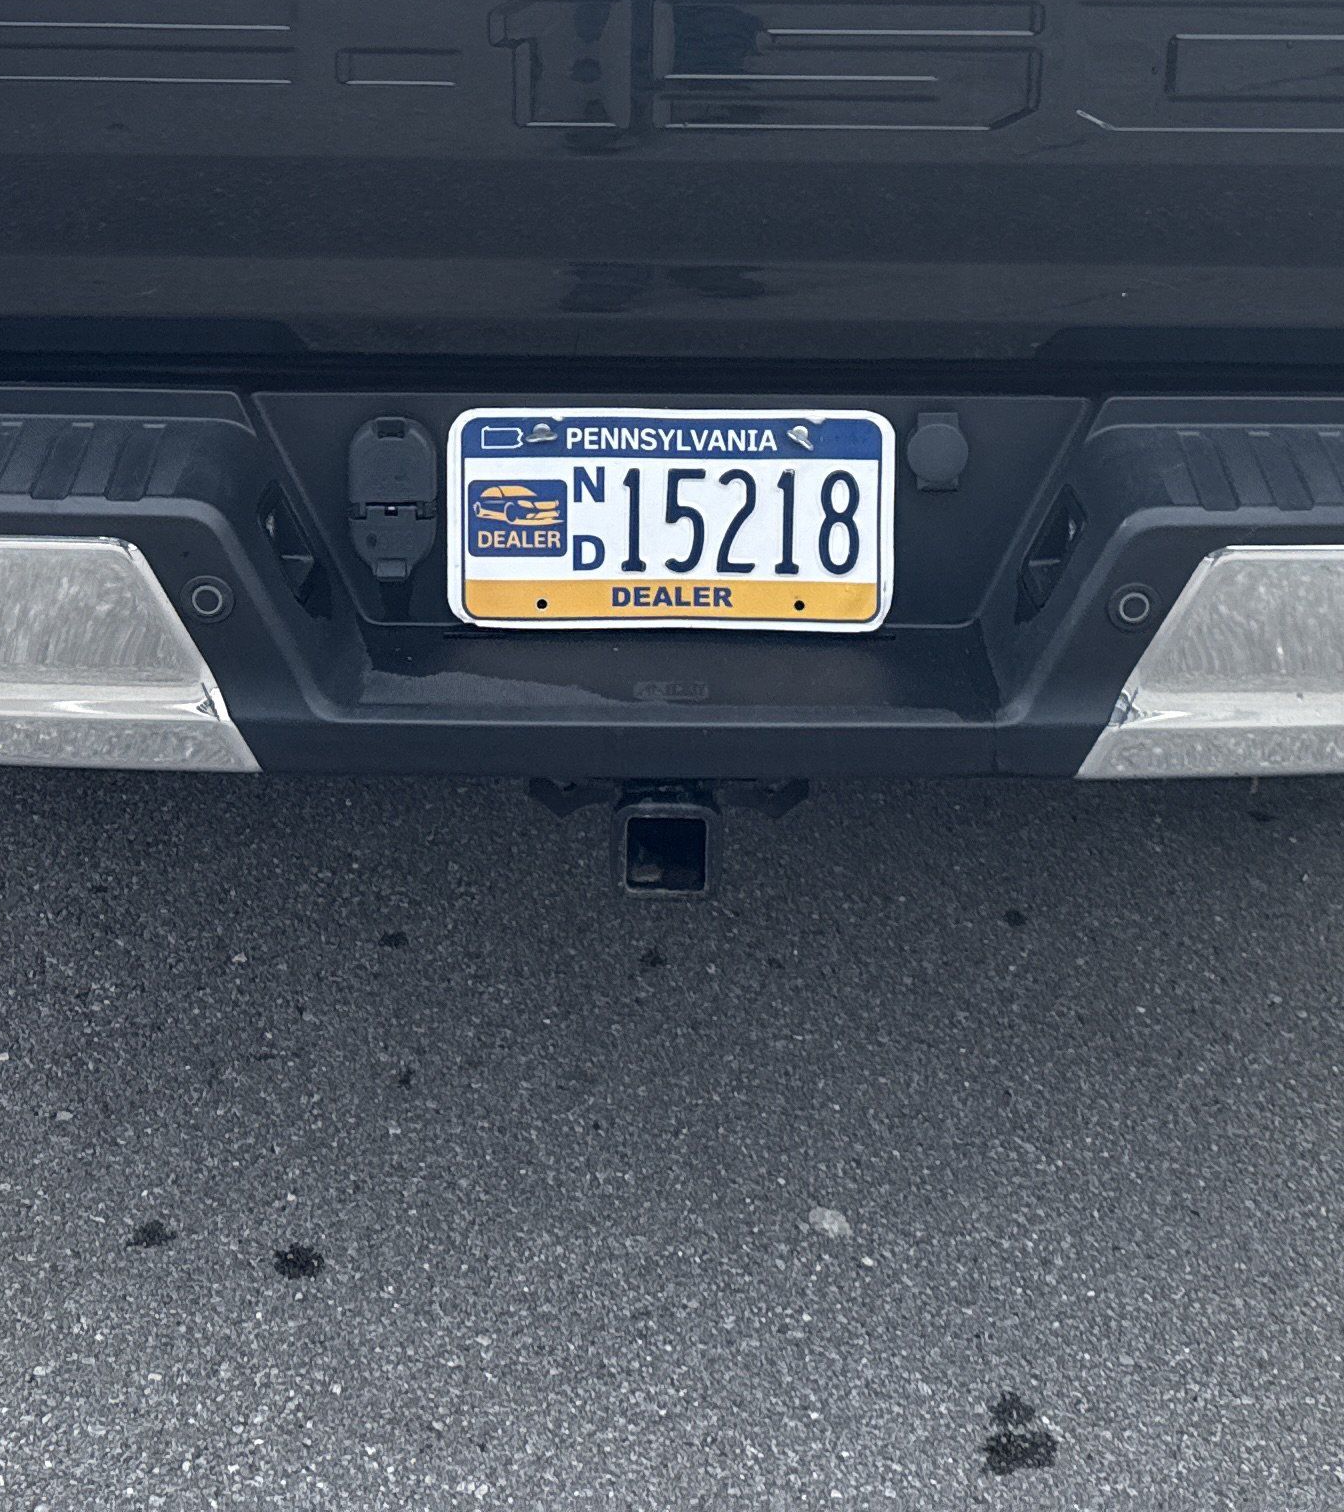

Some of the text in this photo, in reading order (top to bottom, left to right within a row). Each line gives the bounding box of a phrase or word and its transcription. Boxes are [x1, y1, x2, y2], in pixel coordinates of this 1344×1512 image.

[565, 427, 778, 452] PENNSYLVANIA
[620, 467, 860, 575] 15218
[477, 529, 561, 550] DEALER
[611, 585, 733, 608] DEALER
